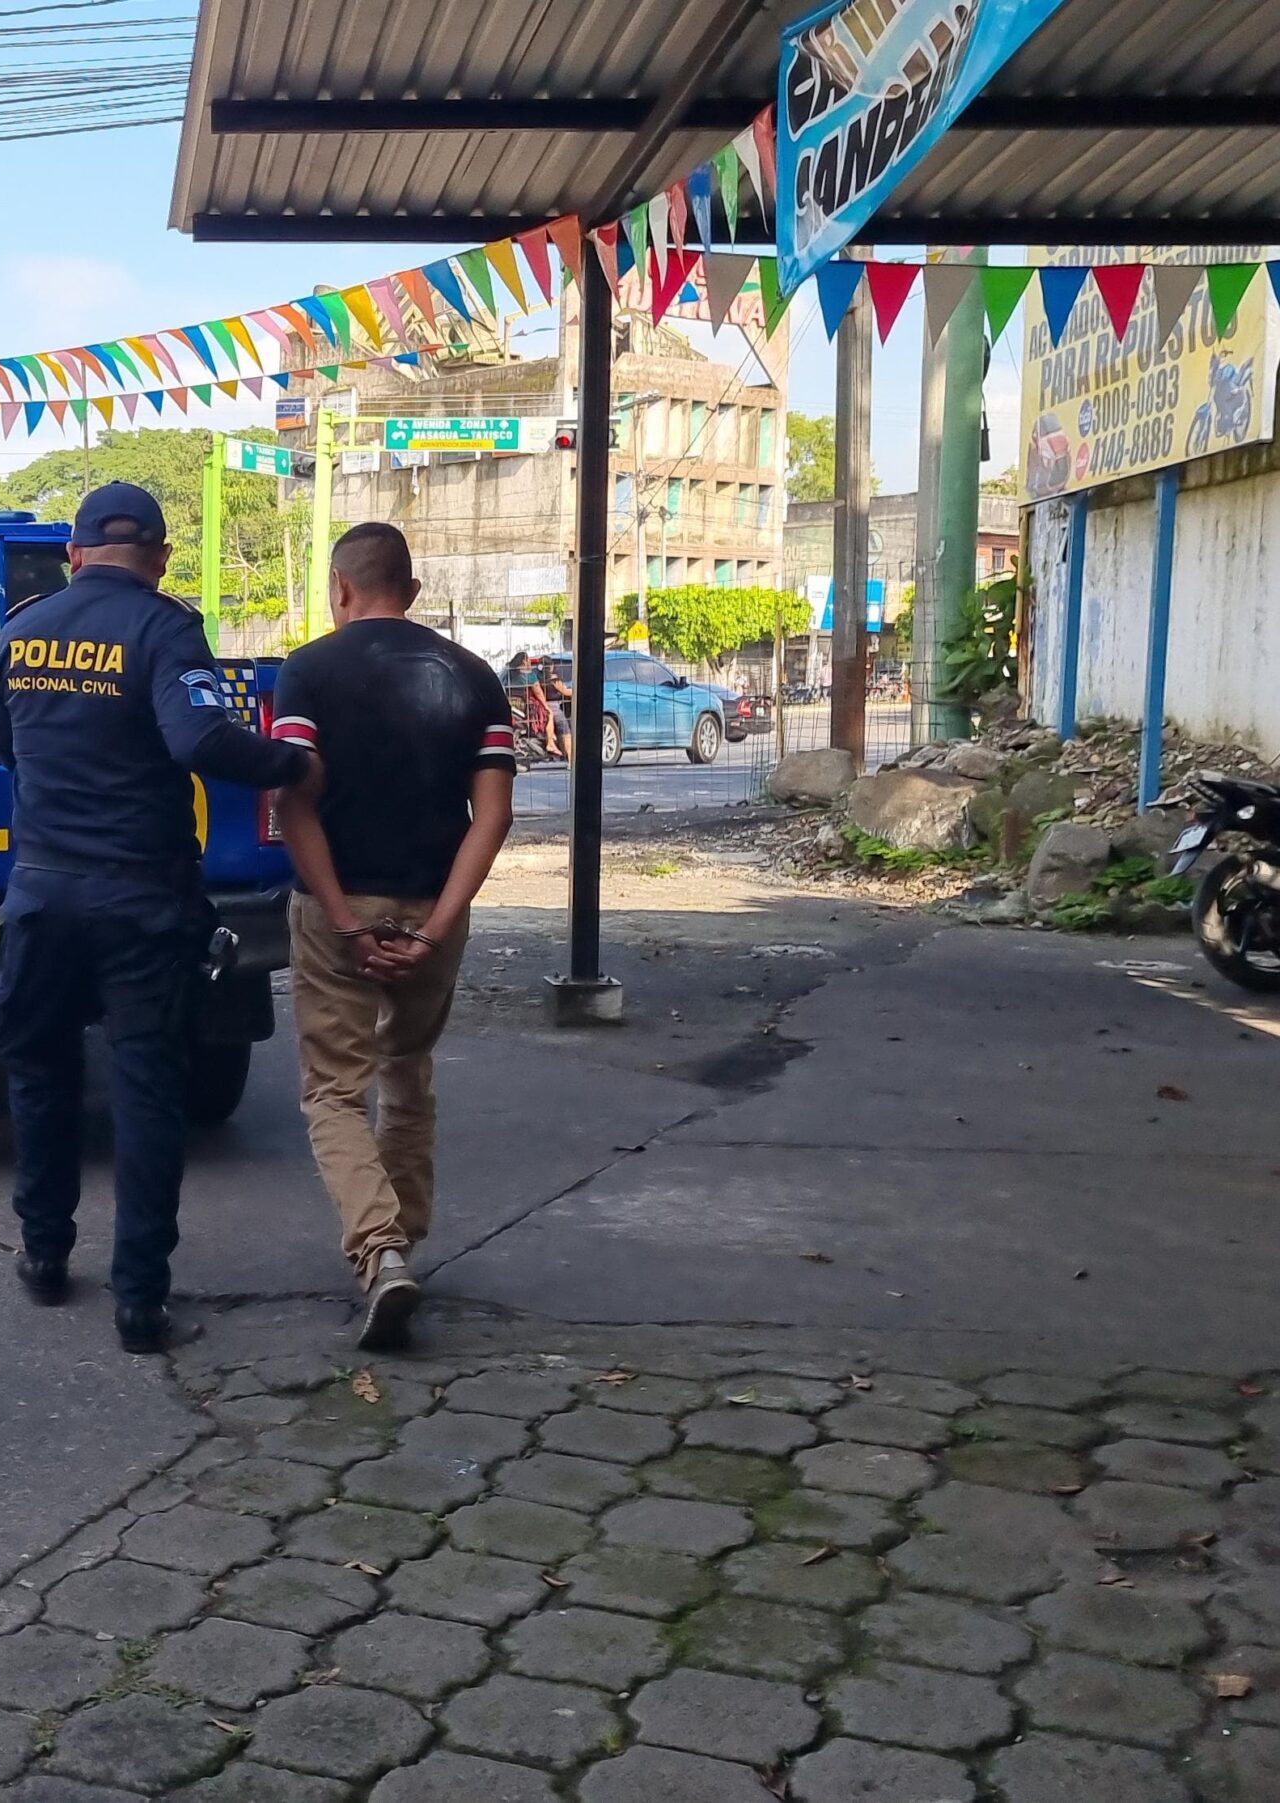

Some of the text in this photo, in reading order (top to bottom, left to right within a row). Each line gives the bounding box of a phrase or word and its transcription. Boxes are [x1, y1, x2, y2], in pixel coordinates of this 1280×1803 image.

[1039, 340, 1091, 411] PARA
[1092, 364, 1180, 436] 3008-0893
[412, 420, 451, 429] AVENIDA
[460, 420, 486, 429] ZONA
[413, 431, 458, 440] MASAGUA
[471, 431, 513, 440] TAXISCO
[10, 639, 124, 673] POLICIA
[8, 677, 123, 696] NACIONAL CIVIL
